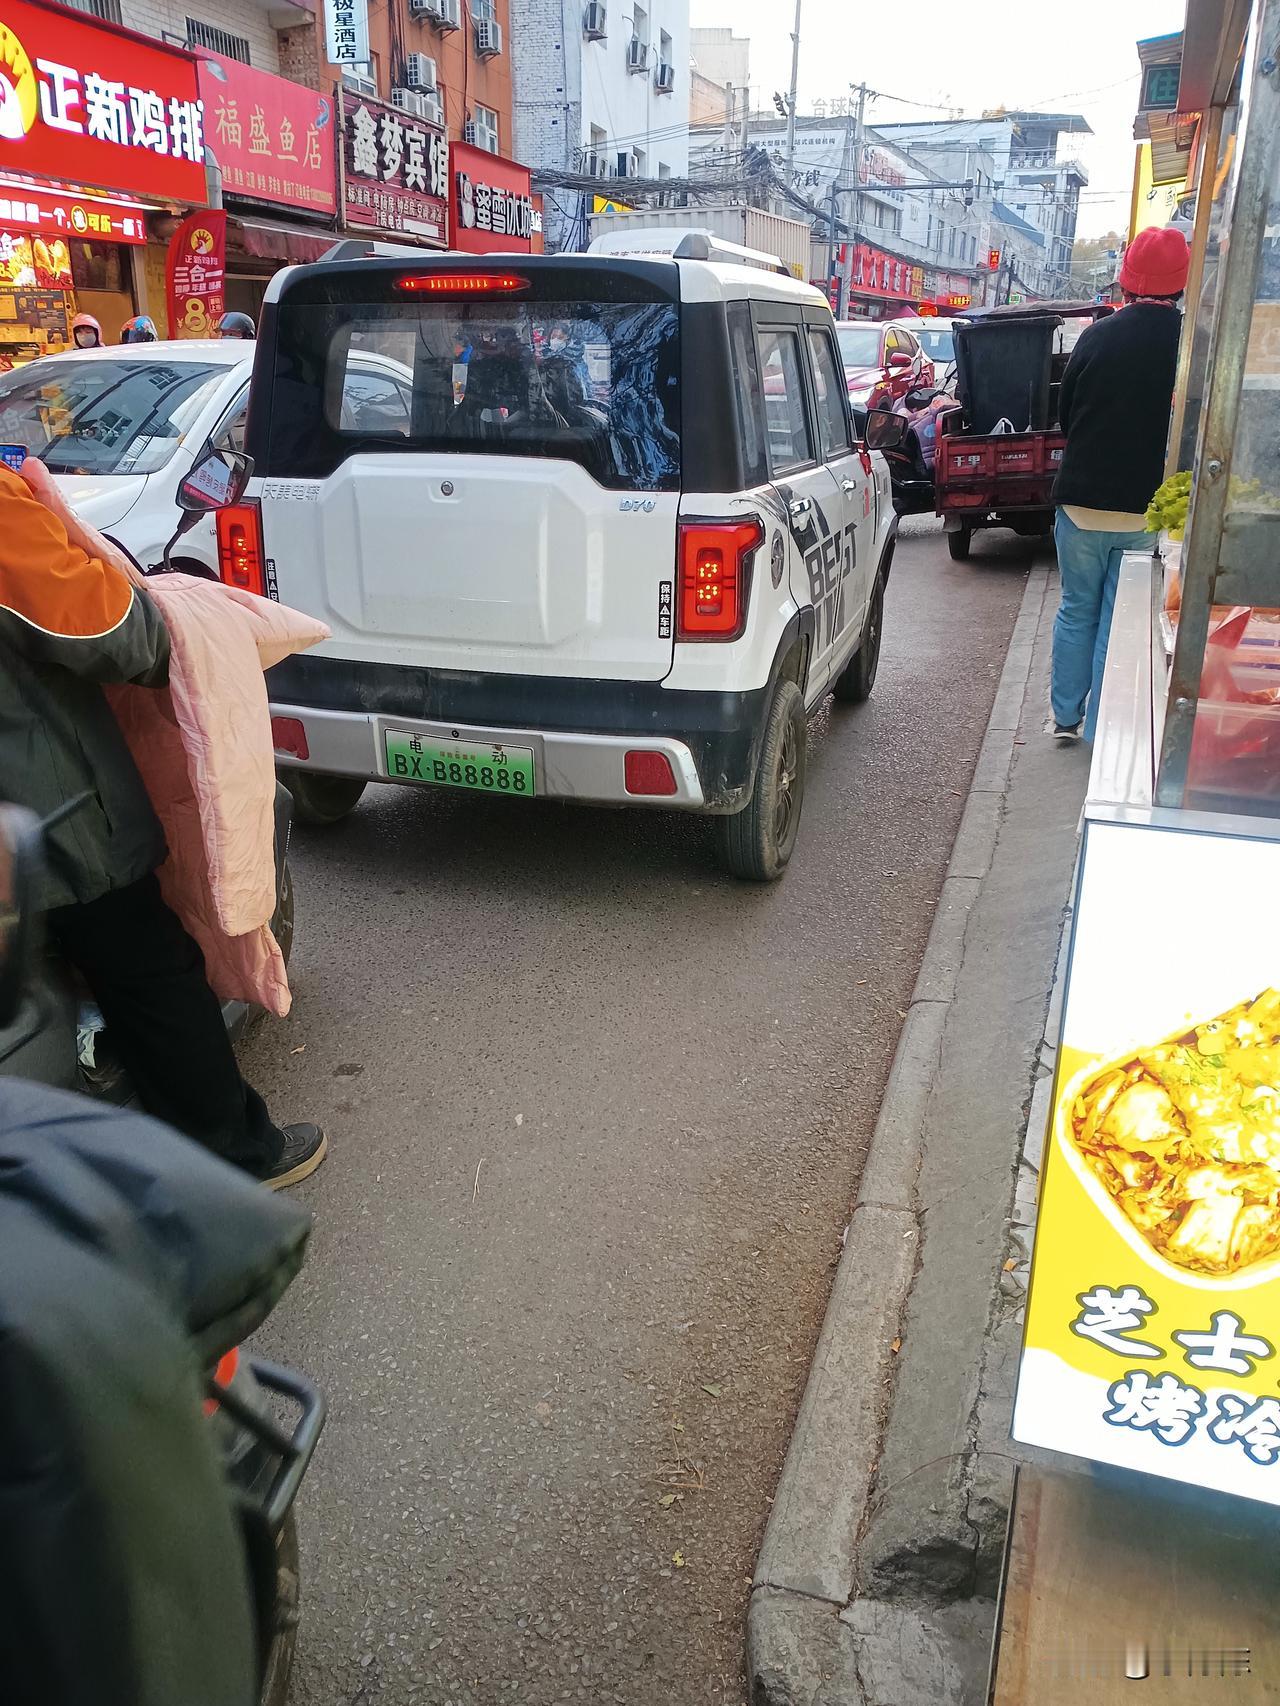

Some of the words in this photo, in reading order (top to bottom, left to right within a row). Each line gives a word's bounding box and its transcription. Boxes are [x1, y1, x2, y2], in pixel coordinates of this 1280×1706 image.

[36, 57, 205, 163] 正新鸡排
[215, 95, 322, 170] 福盛鱼店
[352, 104, 450, 198] 鑫梦宾馆
[173, 264, 223, 283] 三合一
[619, 498, 656, 513] D70
[805, 522, 857, 605] BEST
[410, 739, 424, 755] 电
[492, 751, 508, 766] 动
[1072, 1285, 1272, 1374] 芝士
